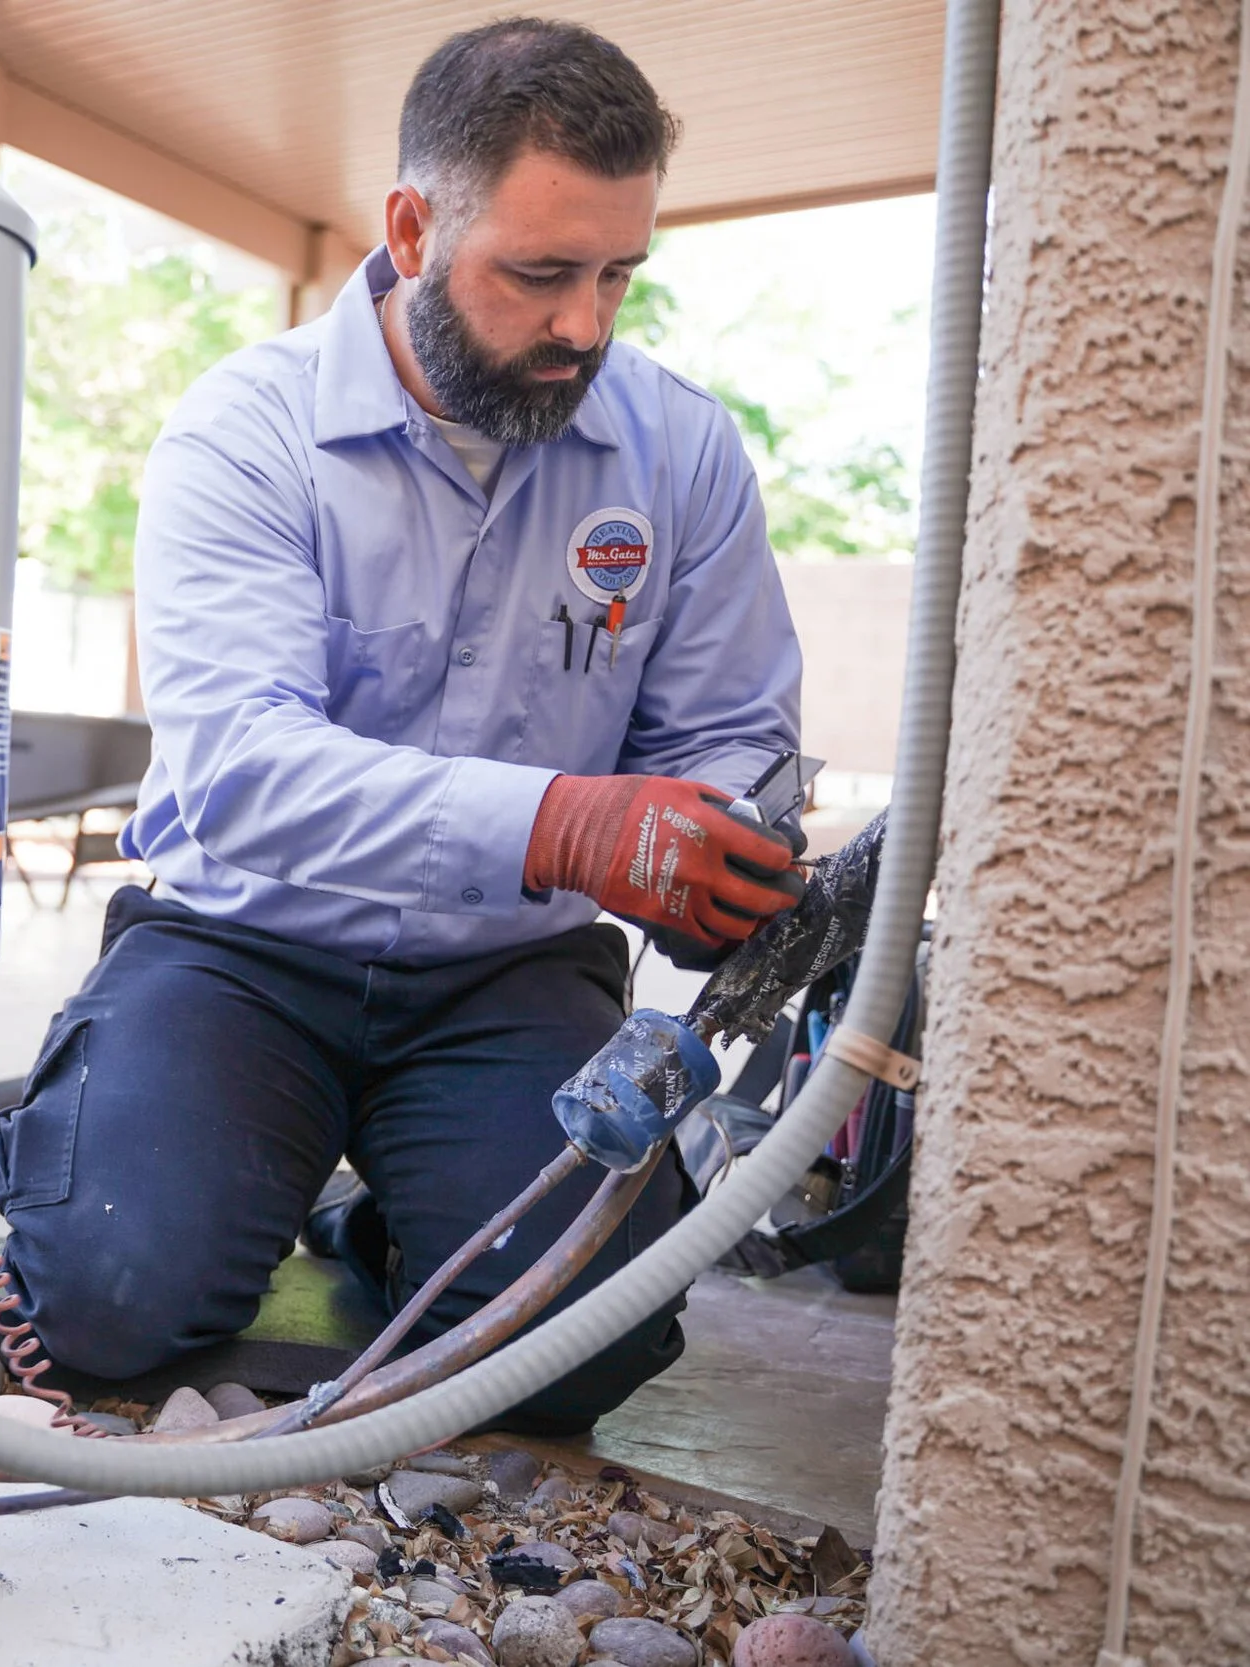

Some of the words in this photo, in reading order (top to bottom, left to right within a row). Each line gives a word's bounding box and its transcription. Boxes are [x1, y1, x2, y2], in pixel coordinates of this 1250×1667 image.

[592, 525, 638, 545] HEATING
[586, 548, 610, 561] Mr.
[610, 547, 641, 561] Gates
[594, 568, 636, 585] COOLING
[628, 802, 655, 889] Milwaukee
[811, 915, 841, 971] RESISTANT
